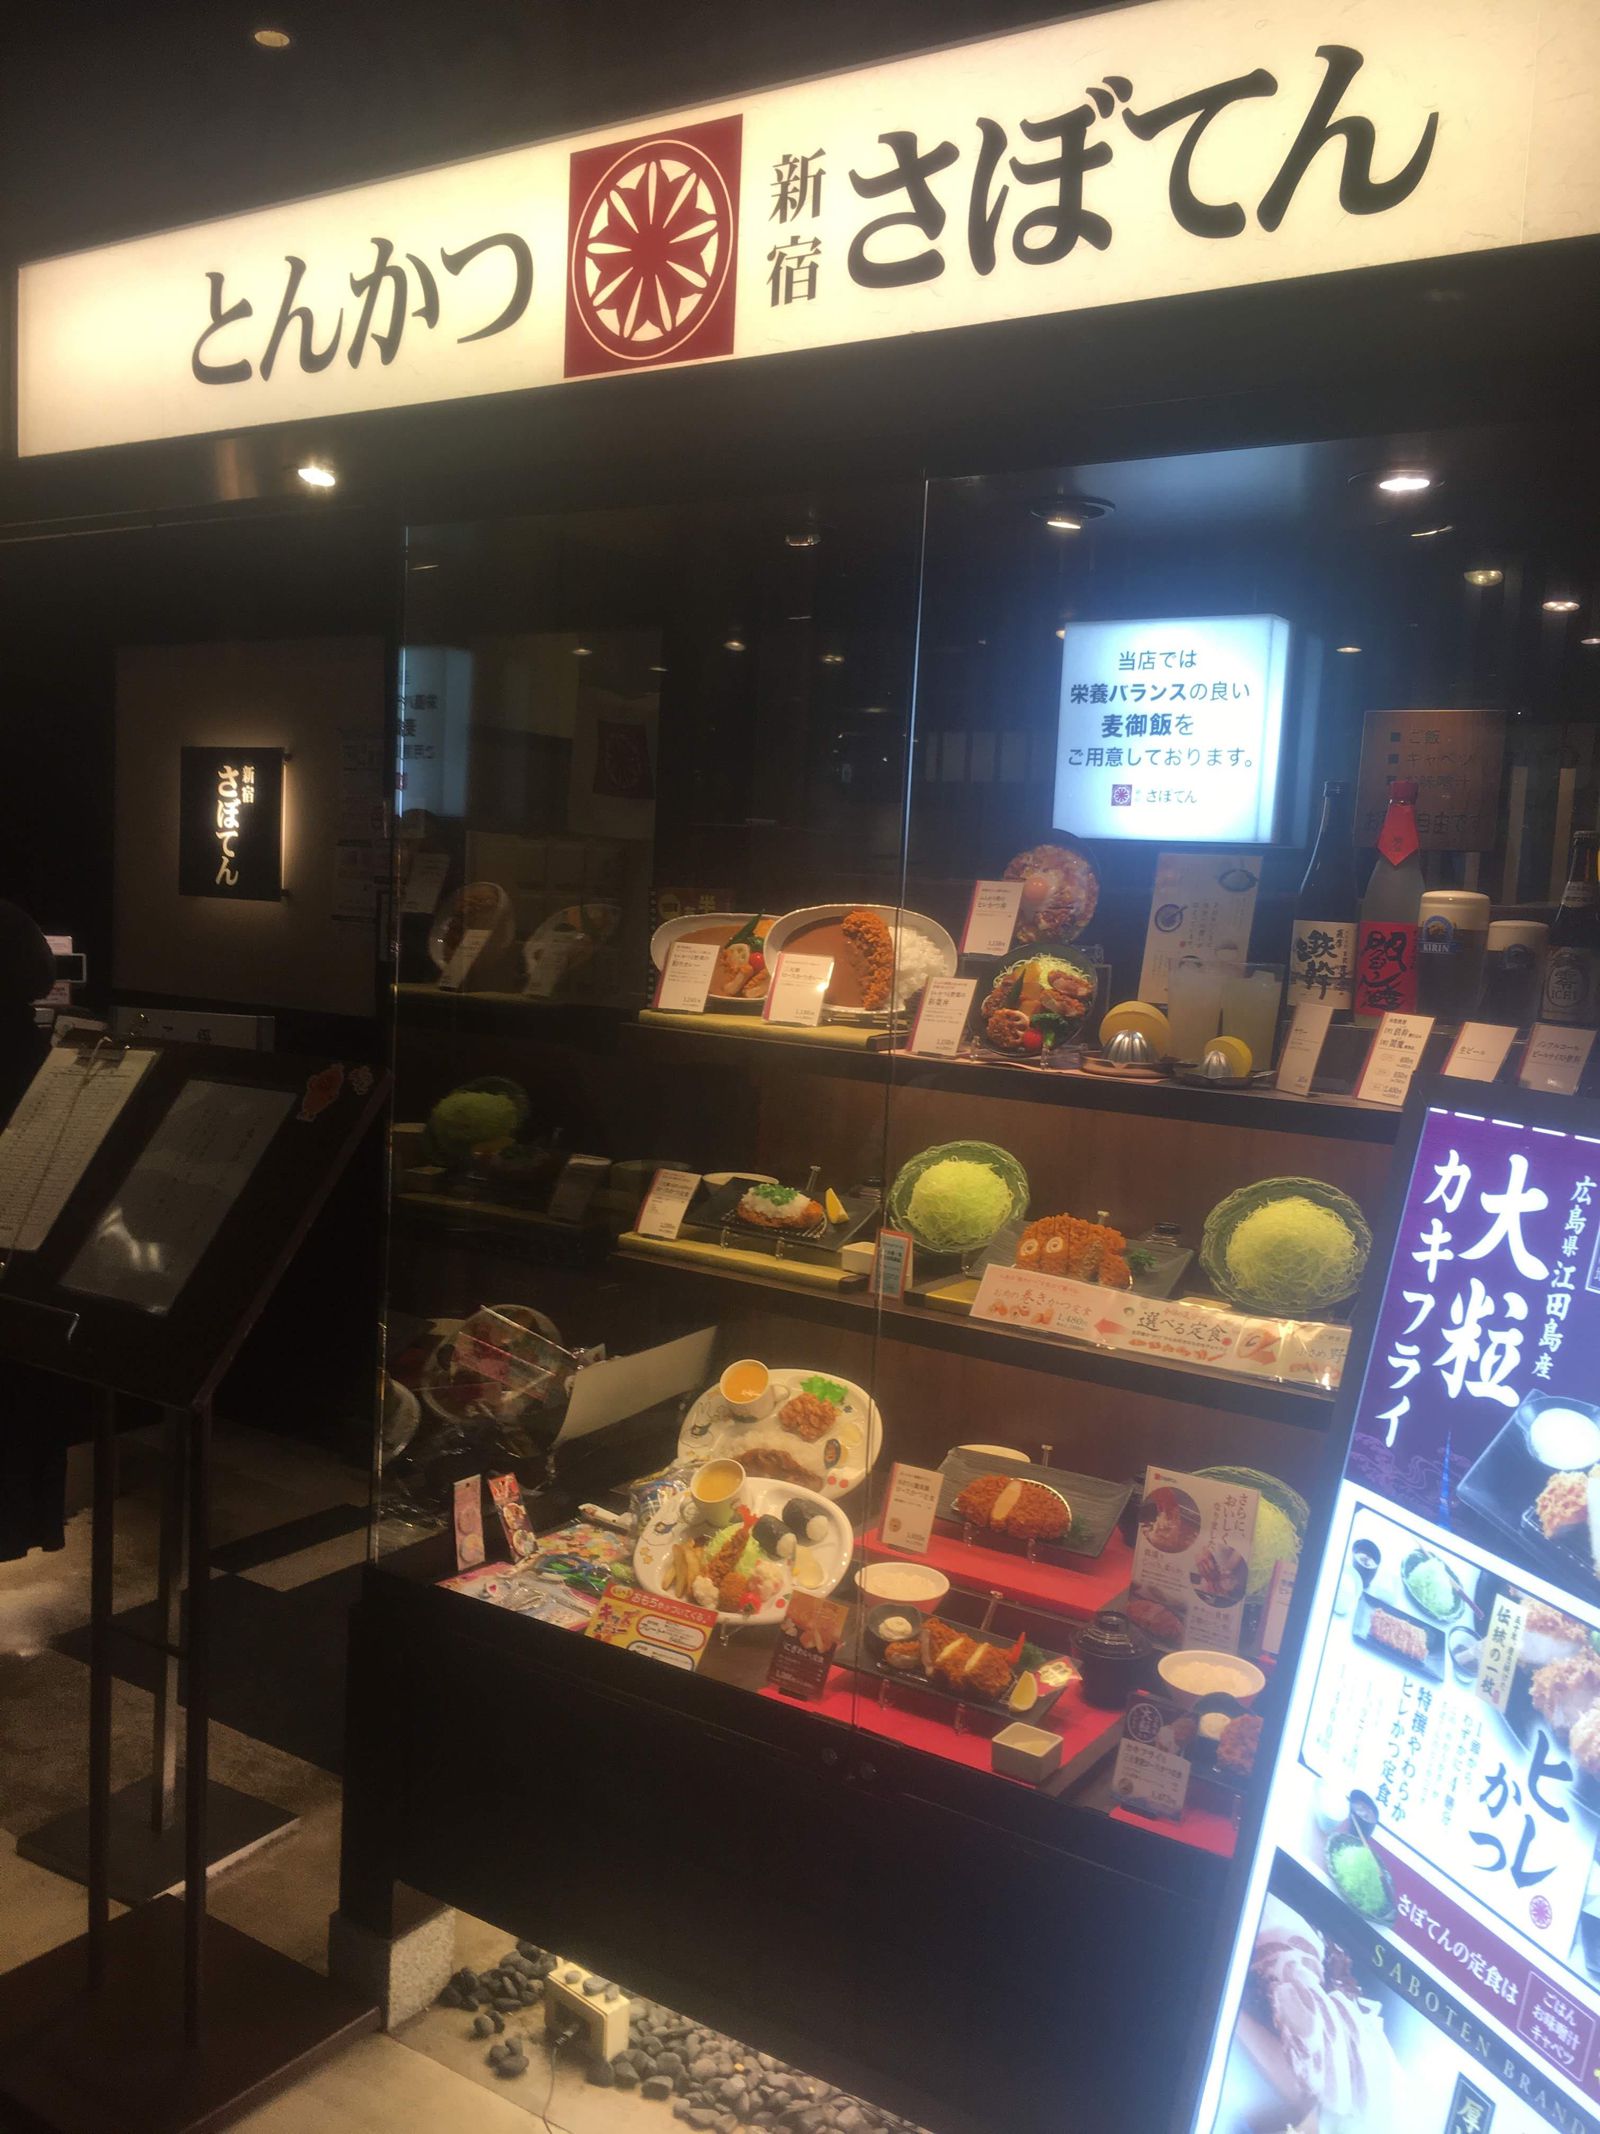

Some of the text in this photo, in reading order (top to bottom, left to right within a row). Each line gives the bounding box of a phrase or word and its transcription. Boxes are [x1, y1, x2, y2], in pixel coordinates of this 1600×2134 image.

[847, 44, 1440, 289] さぼてん
[766, 147, 827, 308] 新宿
[191, 232, 534, 386] とんかつ
[1070, 681, 1250, 704] 栄養バランスの良い
[1117, 650, 1198, 671] 当店では
[241, 765, 256, 804] 新宿
[1068, 747, 1254, 768] ご用意しております。
[1101, 713, 1195, 738] 麦御飯を
[215, 765, 242, 886] さぼてん
[1422, 943, 1451, 953] KIRIN
[1136, 1310, 1229, 1343] 選べる定食
[1375, 1149, 1472, 1448] カキフライ
[1432, 1153, 1550, 1408] 大粒
[1532, 1175, 1597, 1381] 広島県江田島産
[1375, 1675, 1413, 1807] ヒレかつ定食
[1395, 1893, 1521, 2006] さぼてんの定食は
[1372, 1944, 1588, 2134] SABOTEN BRAND
